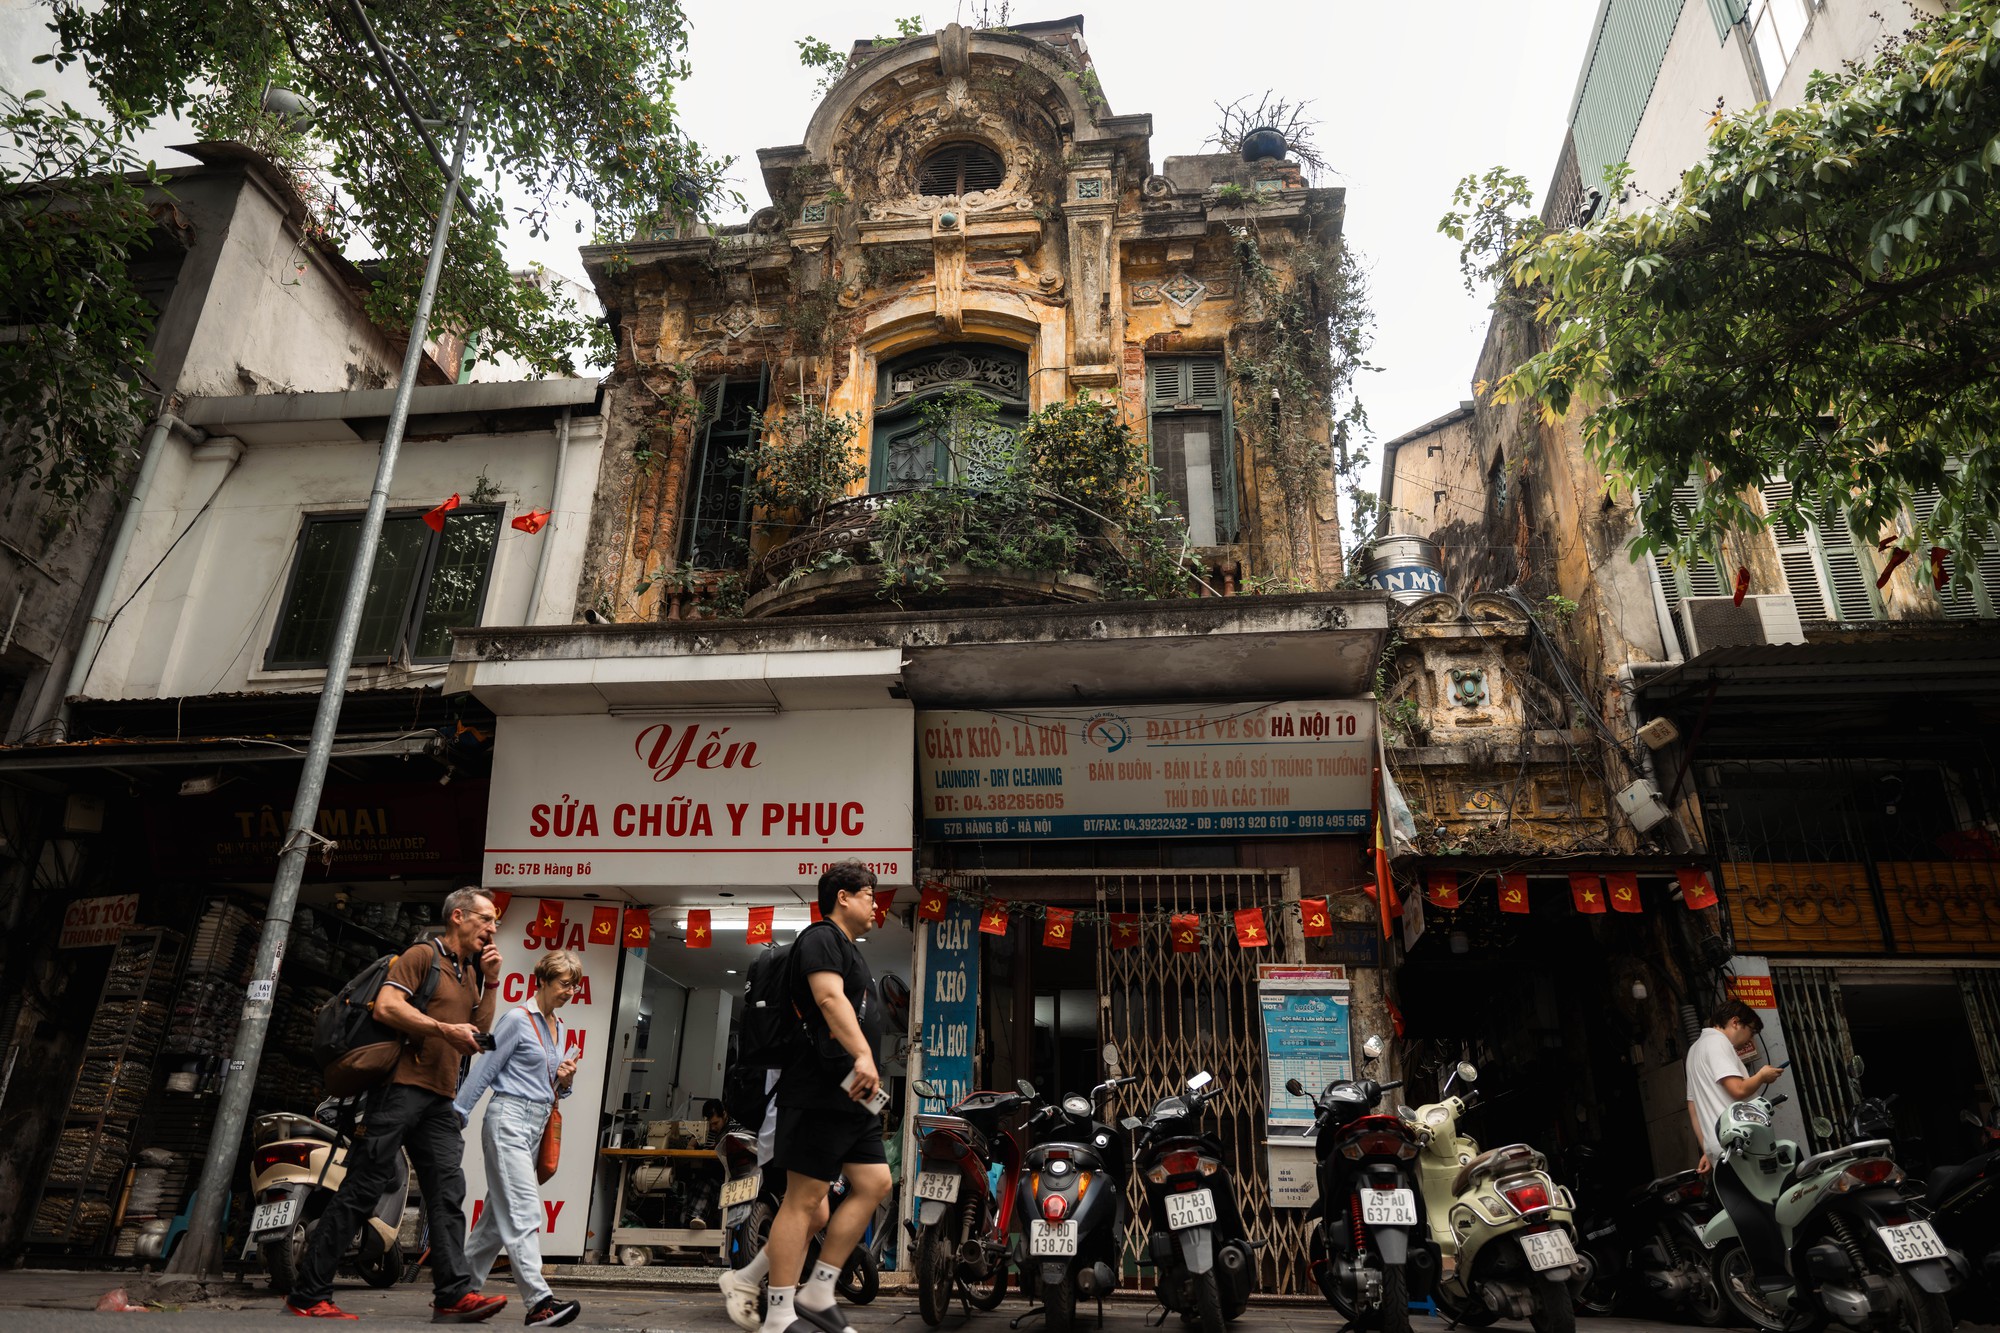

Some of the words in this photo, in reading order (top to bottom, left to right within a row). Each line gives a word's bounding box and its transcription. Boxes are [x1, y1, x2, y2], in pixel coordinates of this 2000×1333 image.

[1146, 720, 1180, 745] ĐẠI
[1185, 713, 1208, 739] LÝ
[1243, 708, 1267, 738] SỐ
[1271, 713, 1294, 737] HÀ
[1300, 711, 1330, 741] NỘI
[1336, 715, 1356, 736] 10
[925, 719, 963, 766] GIẶT
[967, 716, 1001, 758] KHÔ
[1013, 716, 1036, 757] LÀ
[1038, 721, 1068, 756] HƠI
[635, 724, 762, 782] Yến
[1089, 759, 1114, 781] BÁN
[1118, 758, 1152, 780] BUÔN
[1164, 758, 1190, 779] BÁN
[1194, 753, 1208, 779] LẺ
[1213, 760, 1221, 779] &
[1225, 752, 1246, 778] ĐỔI
[1251, 752, 1268, 778] SỐ
[1271, 755, 1312, 777] TRÚNG
[1317, 750, 1367, 776] THƯỞNG
[935, 768, 980, 788] LAUNDRY
[990, 769, 1009, 787] DRY
[1013, 767, 1062, 786] CLEANING
[935, 796, 958, 811] ĐT:
[963, 793, 1064, 811] 04.38285605
[1164, 781, 1188, 808] THỦ
[1192, 785, 1208, 807] ĐÔ
[1212, 785, 1228, 807] VÀ
[1232, 784, 1257, 806] CÁC
[1261, 780, 1289, 806] TỈNH
[234, 805, 294, 838] TÂ
[318, 807, 388, 836] MAI
[530, 794, 599, 837] SỬA
[613, 796, 713, 837] CHỮA
[726, 804, 749, 836] Y
[762, 802, 864, 843] PHỤC
[944, 822, 962, 835] 57B
[965, 819, 992, 834] HÀNG
[1018, 818, 1032, 833] HÀ
[1034, 818, 1052, 835] NỘI
[1084, 819, 1120, 831] ĐT/FAX:
[1124, 818, 1187, 831] 04.39232432
[1220, 816, 1245, 829] 0913
[1248, 816, 1267, 828] 920
[1270, 815, 1288, 828] 610
[1299, 815, 1324, 827] 0918
[1326, 815, 1345, 827] 495
[1347, 815, 1366, 827] 565
[495, 863, 515, 875] ĐC:
[518, 864, 540, 875] 57B
[544, 862, 573, 877] Hàng
[798, 863, 818, 875] ĐT:
[64, 899, 100, 926] CẮT
[103, 897, 137, 923] TÓC
[63, 929, 103, 944] TRONG
[936, 910, 971, 957] GIẶT
[935, 961, 967, 1002] KHÔ
[929, 1014, 944, 1057] LÀ
[947, 1020, 968, 1057] HƠI
[726, 1178, 753, 1194] 30-H3
[923, 1174, 954, 1187] 29-X2
[920, 1185, 953, 1199] 0967
[260, 1202, 290, 1217] 30-L9
[1173, 1193, 1205, 1210] 17-B3
[256, 1214, 287, 1229] 0460
[1171, 1207, 1212, 1226] 620.10
[1367, 1208, 1412, 1222] 637.84
[1888, 1225, 1927, 1243] 29-C1
[1035, 1239, 1073, 1253] 138.76
[1893, 1239, 1942, 1260] 650.81
[1531, 1248, 1574, 1268] 003.70
